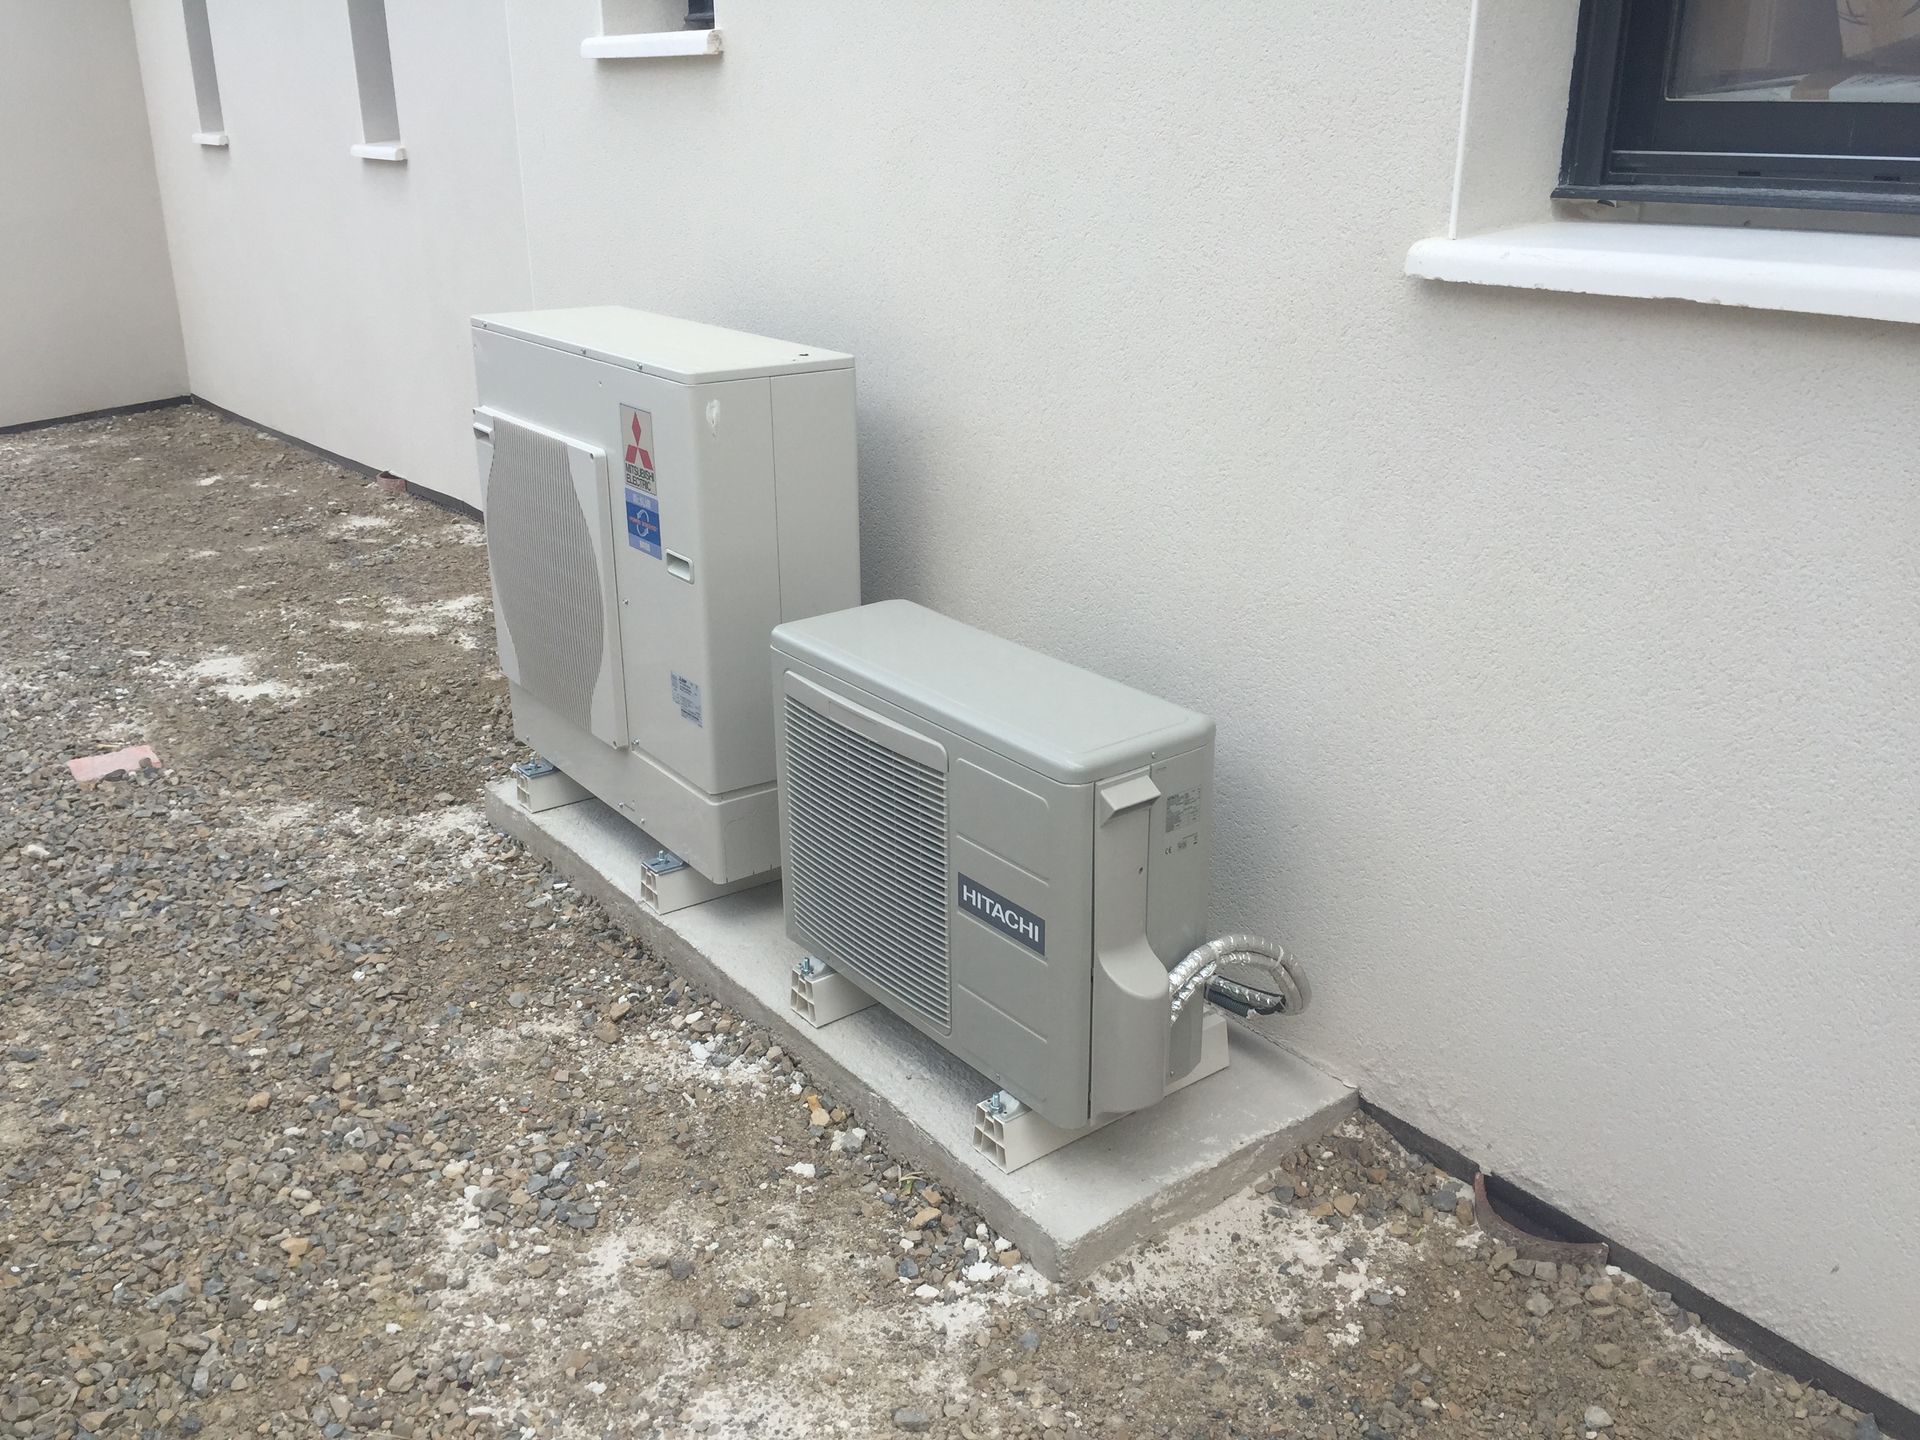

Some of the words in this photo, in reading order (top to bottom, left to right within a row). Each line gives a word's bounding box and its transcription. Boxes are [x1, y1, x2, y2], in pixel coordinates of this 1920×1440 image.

[625, 463, 655, 482] MITSUBISHI
[626, 473, 652, 491] ELECTRIC
[963, 884, 1039, 942] HITACHI
